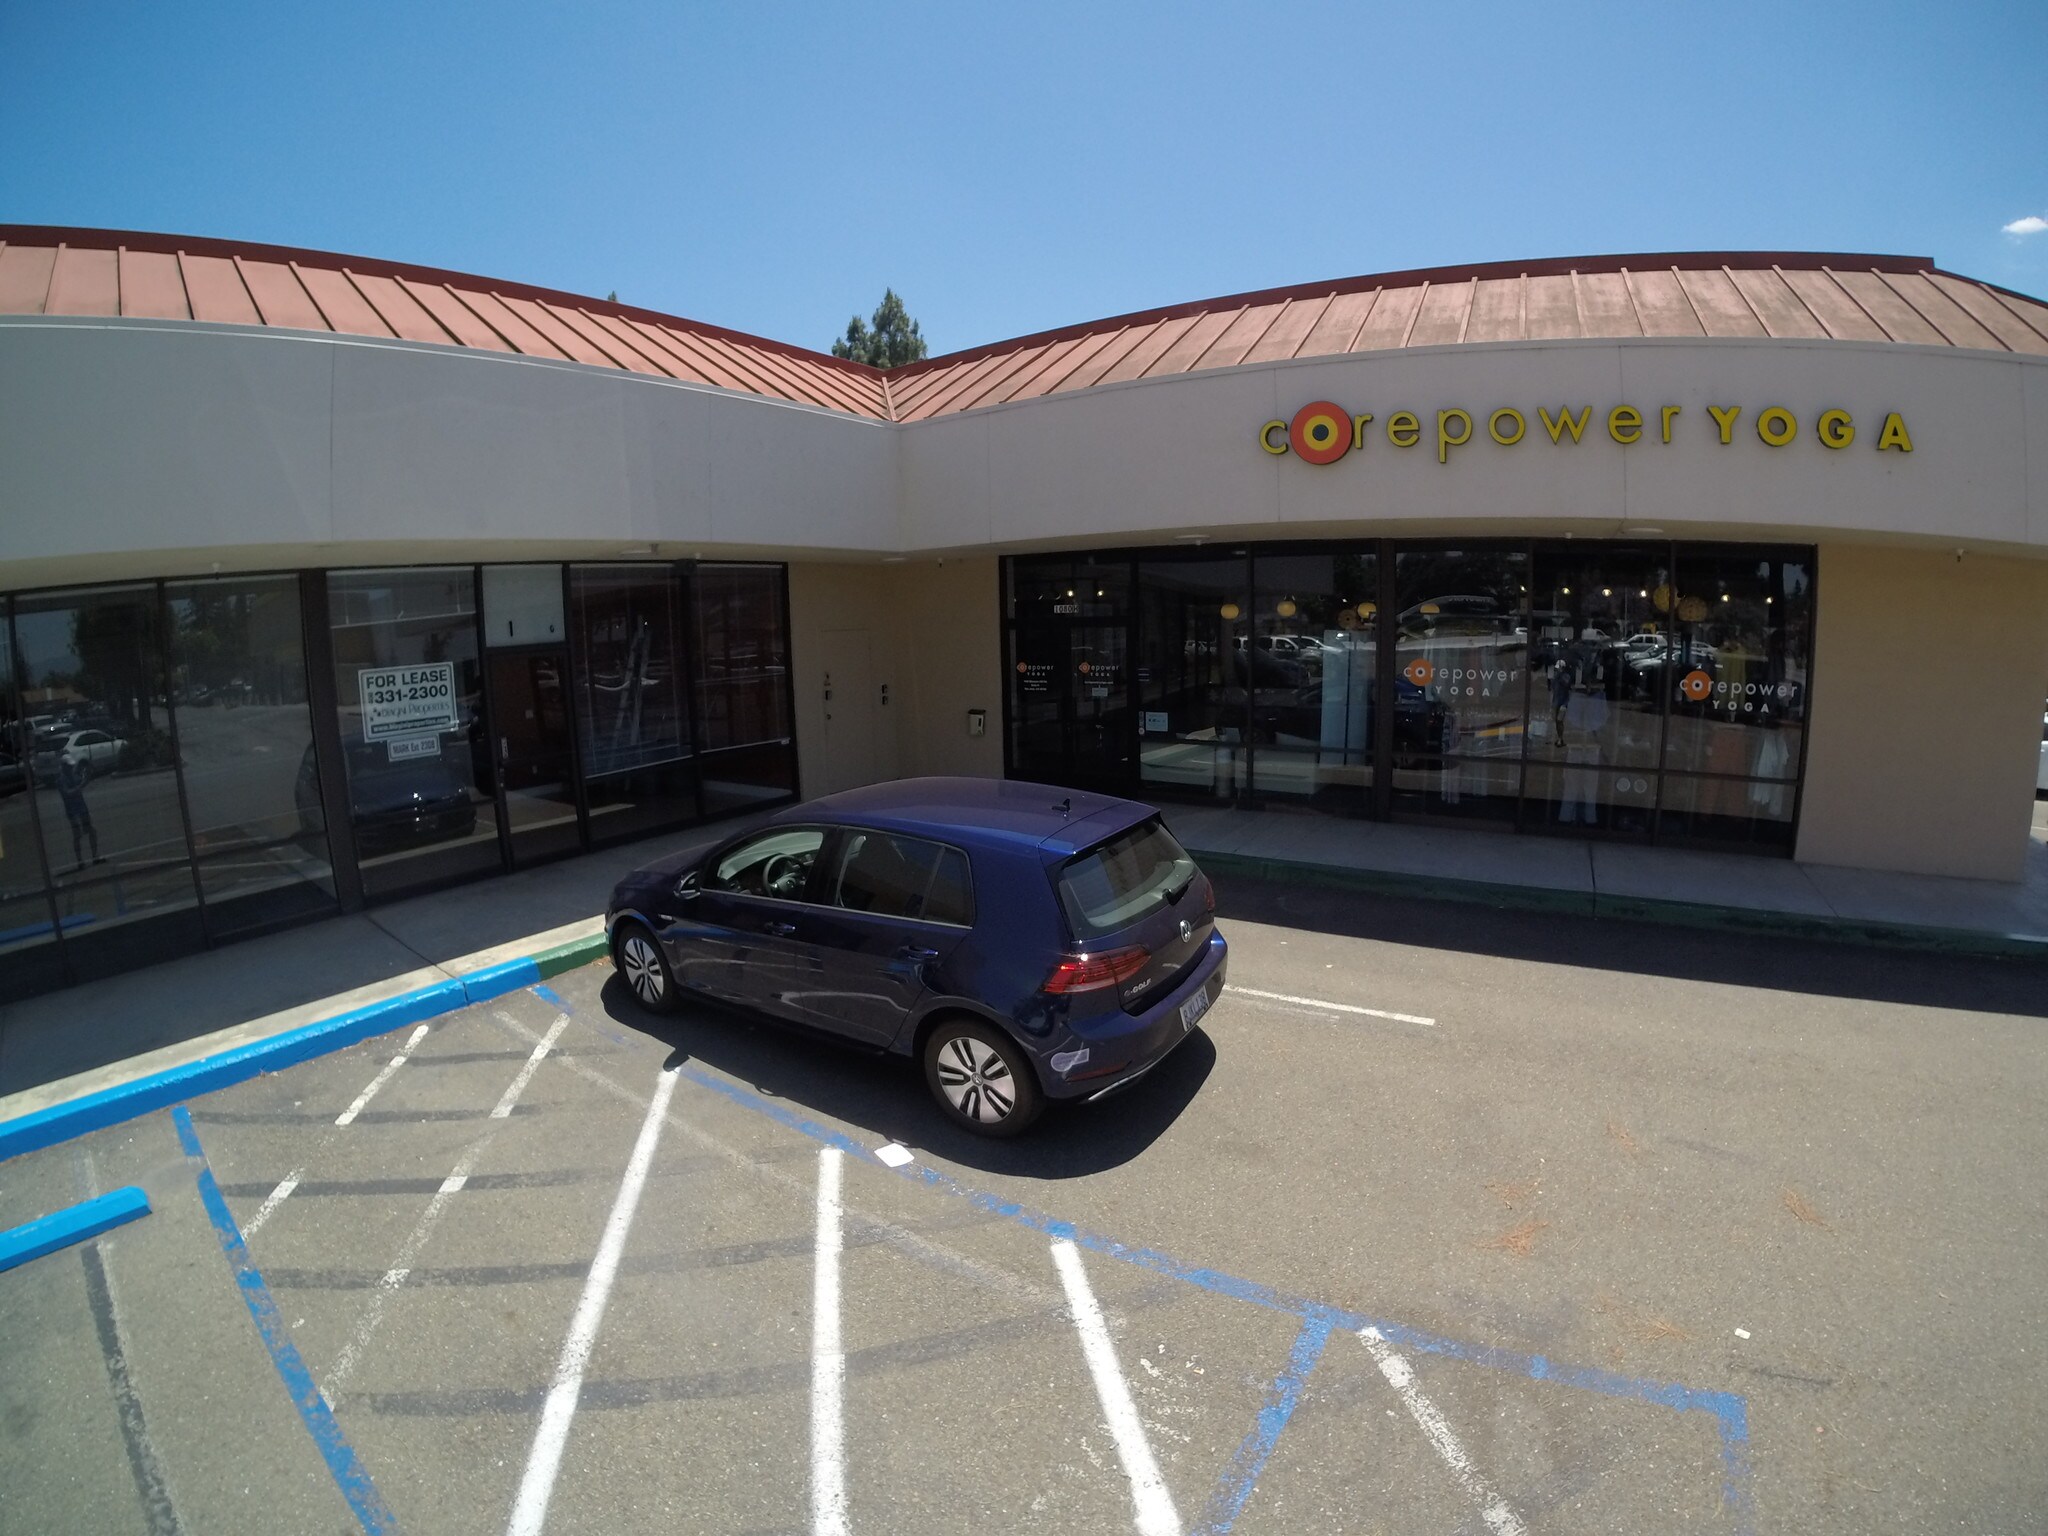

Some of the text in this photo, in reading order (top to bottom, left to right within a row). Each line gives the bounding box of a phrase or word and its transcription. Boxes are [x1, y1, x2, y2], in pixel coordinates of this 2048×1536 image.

[1259, 401, 1914, 464] corepower YOGA
[366, 669, 448, 689] FOR LEASE
[1403, 665, 1518, 684] corepower
[374, 684, 448, 704] 331-2300
[1435, 685, 1490, 697] YOGA
[1680, 679, 1798, 698] corepower
[1712, 700, 1770, 713] YOGA
